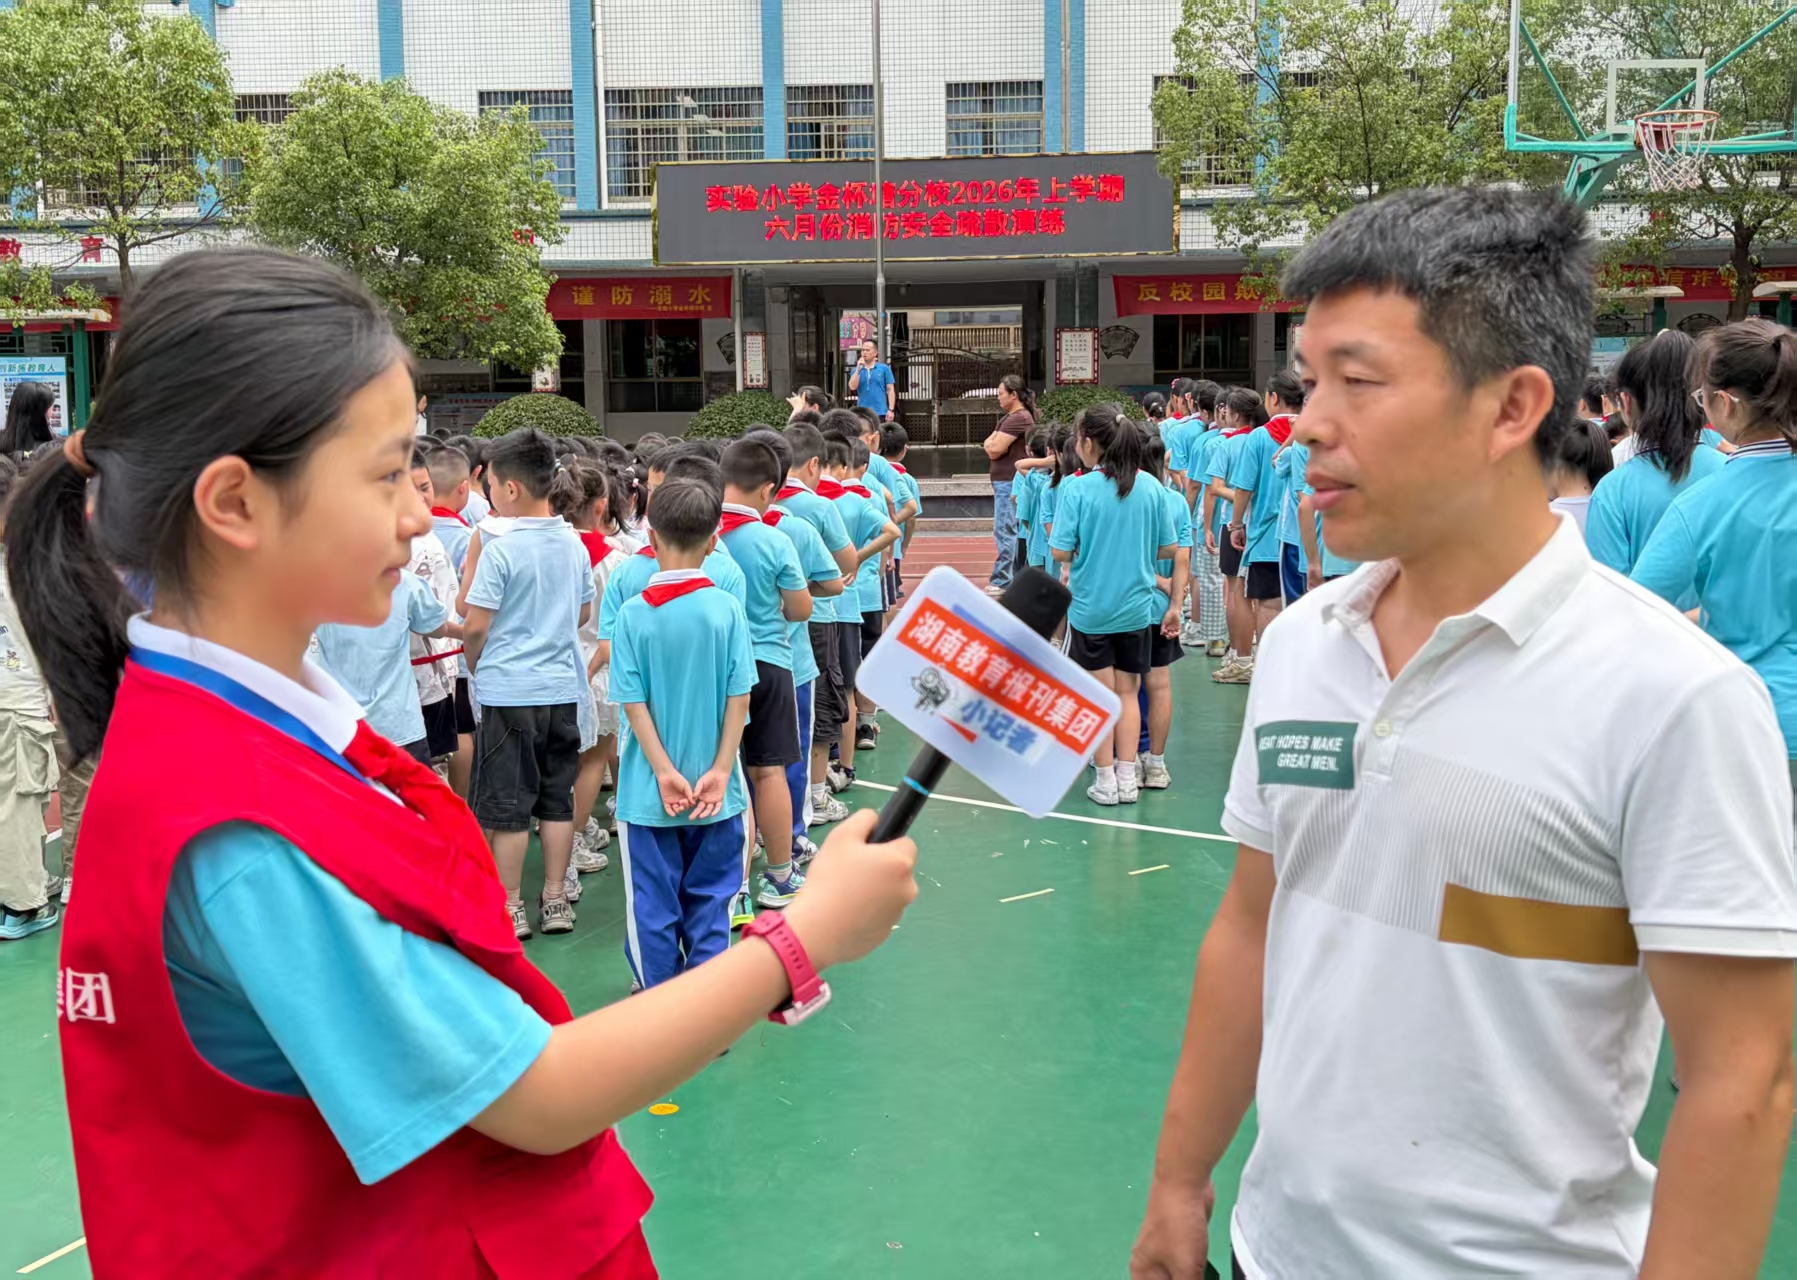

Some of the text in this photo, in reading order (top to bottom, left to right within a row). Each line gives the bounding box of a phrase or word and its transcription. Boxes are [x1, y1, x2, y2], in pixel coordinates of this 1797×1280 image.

[765, 207, 1065, 241] 六月份消防安全疏散演练
[572, 284, 711, 306] 谨防溺水
[908, 610, 1102, 744] 湖南教育报刊集团
[959, 699, 1041, 756] 小记者
[1276, 734, 1310, 750] HOPES
[1311, 736, 1344, 752] MAKE
[1277, 753, 1339, 772] GREAT MEN.
[57, 967, 116, 1024] 团
